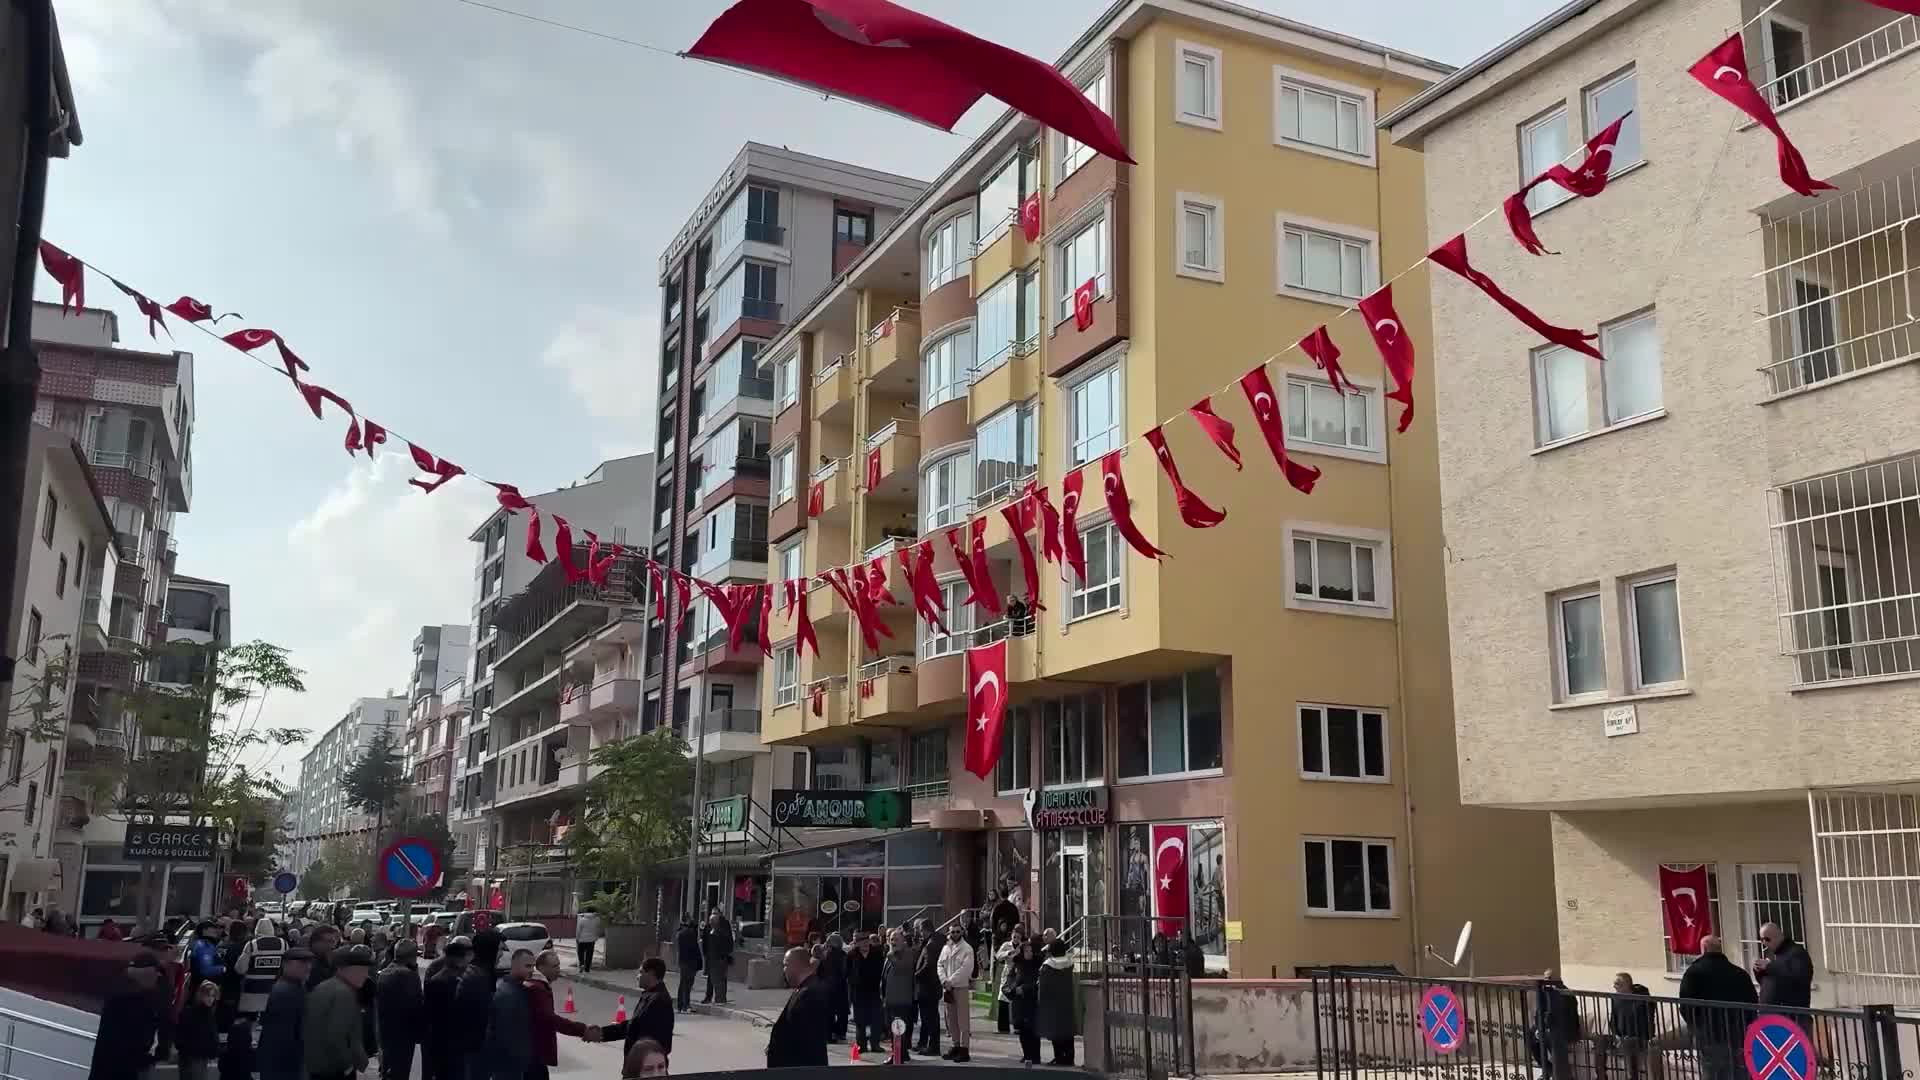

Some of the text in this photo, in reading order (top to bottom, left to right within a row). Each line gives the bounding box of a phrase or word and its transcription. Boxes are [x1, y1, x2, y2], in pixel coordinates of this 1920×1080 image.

[775, 792, 866, 824] Cafe AMOUR
[1036, 808, 1106, 827] FITNESS CLUB
